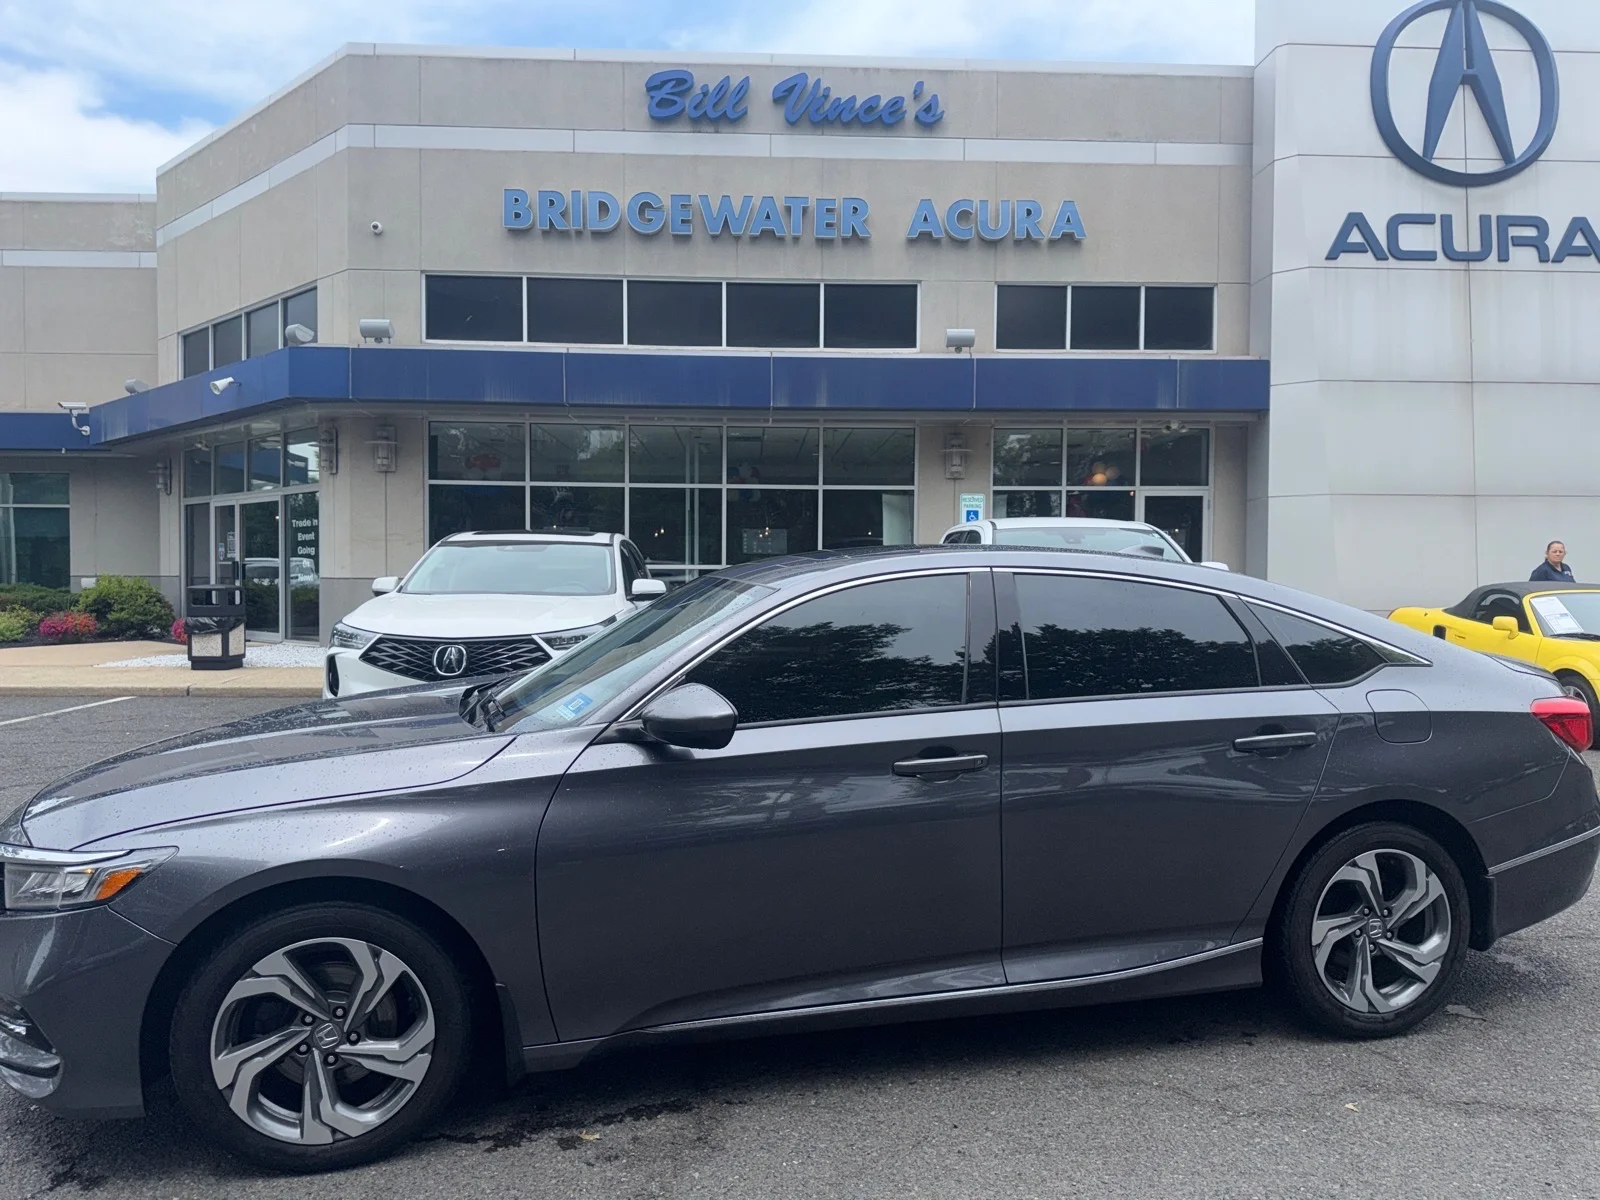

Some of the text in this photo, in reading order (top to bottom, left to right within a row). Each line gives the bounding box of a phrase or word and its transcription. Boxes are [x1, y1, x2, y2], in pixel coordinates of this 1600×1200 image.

[645, 69, 945, 126] Bill Vince's
[503, 188, 1087, 241] BRIDGEWATER ACURA
[1325, 212, 1600, 263] ACURA
[292, 519, 311, 527] Trade
[297, 532, 315, 541] Event
[297, 546, 315, 555] Going
